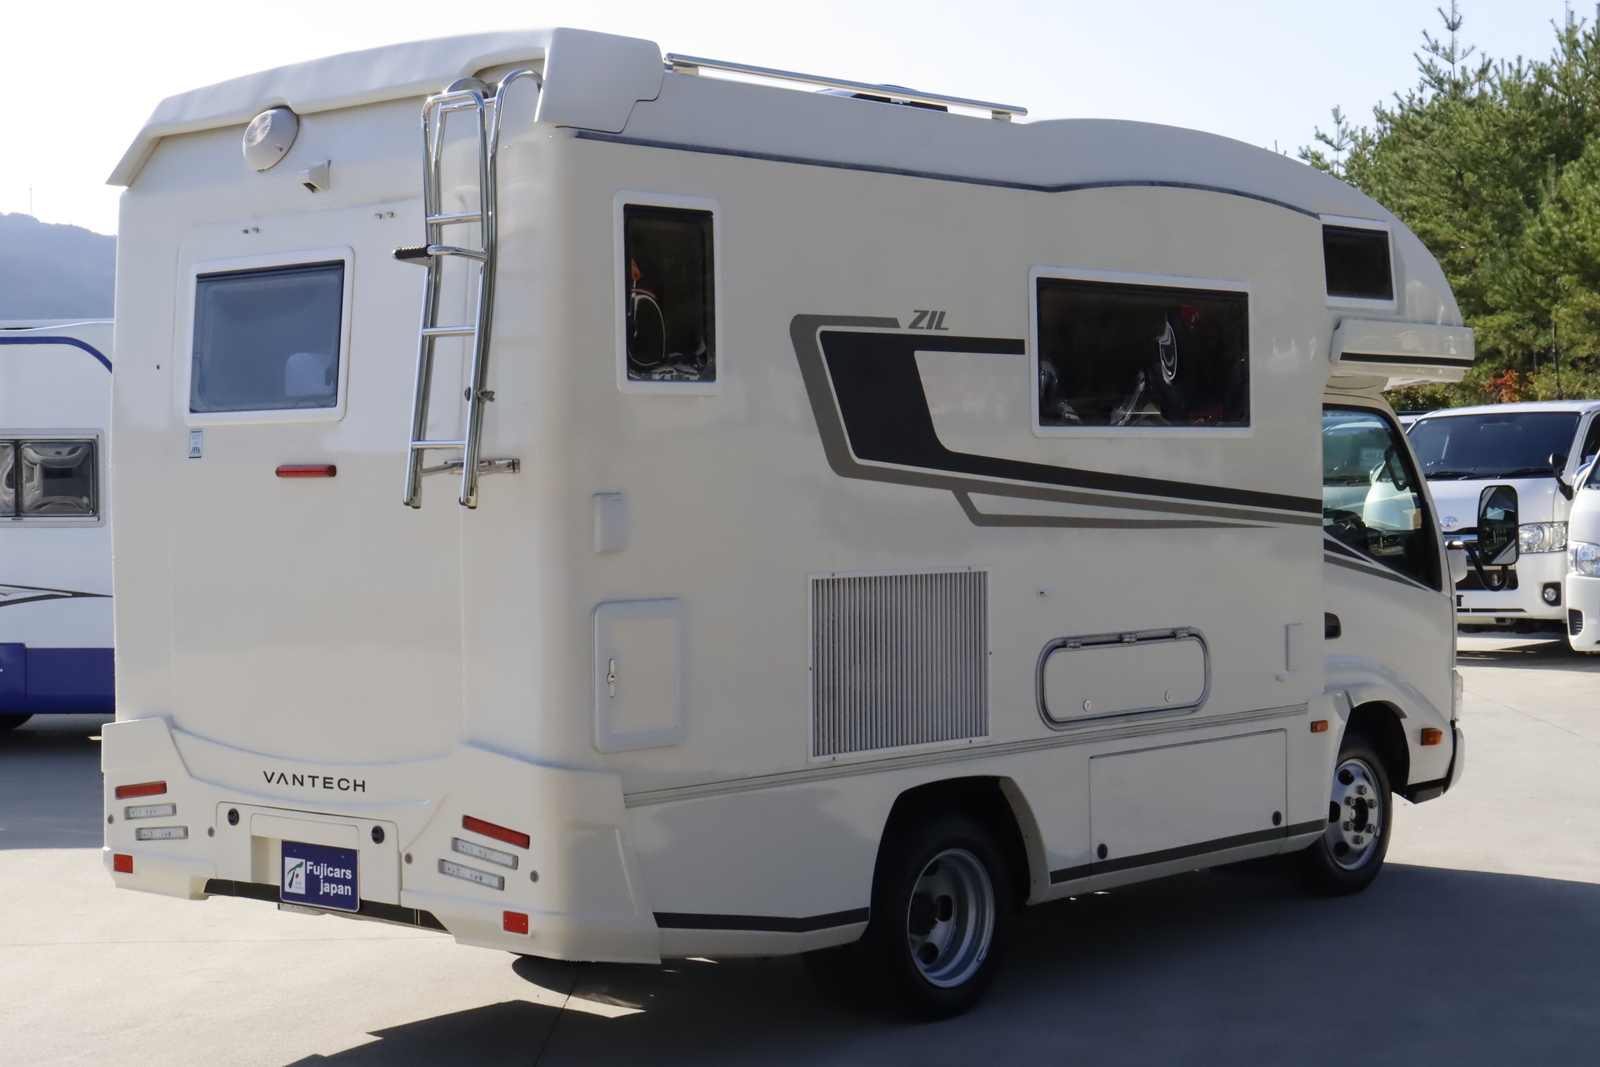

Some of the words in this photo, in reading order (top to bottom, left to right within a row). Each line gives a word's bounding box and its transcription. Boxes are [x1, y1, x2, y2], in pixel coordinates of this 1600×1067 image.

[908, 309, 949, 330] ZIL
[263, 771, 366, 792] VANTECH
[306, 861, 352, 879] Fujicars
[319, 879, 352, 896] japan
